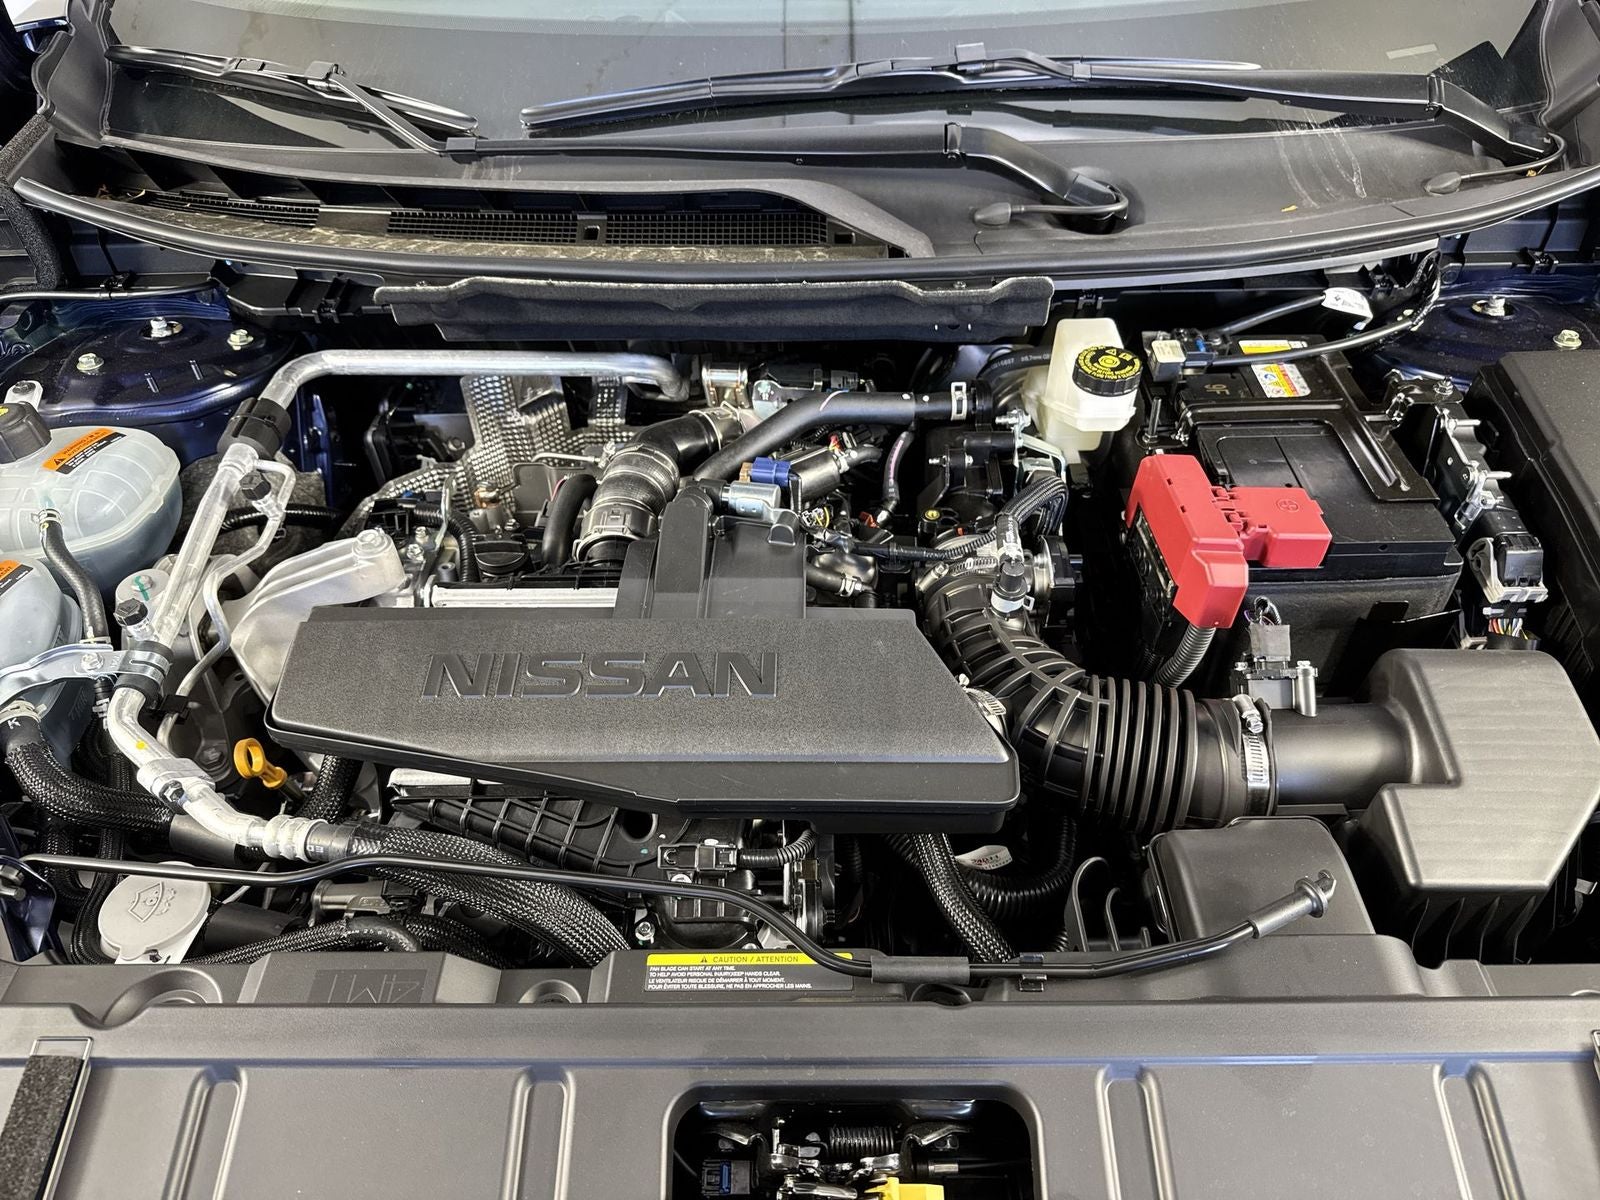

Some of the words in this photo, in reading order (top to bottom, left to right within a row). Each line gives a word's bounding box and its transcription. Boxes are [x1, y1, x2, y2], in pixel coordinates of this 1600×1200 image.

[422, 652, 778, 698] NISSAN
[7, 717, 22, 730] K
[755, 955, 799, 963] ATTENTION
